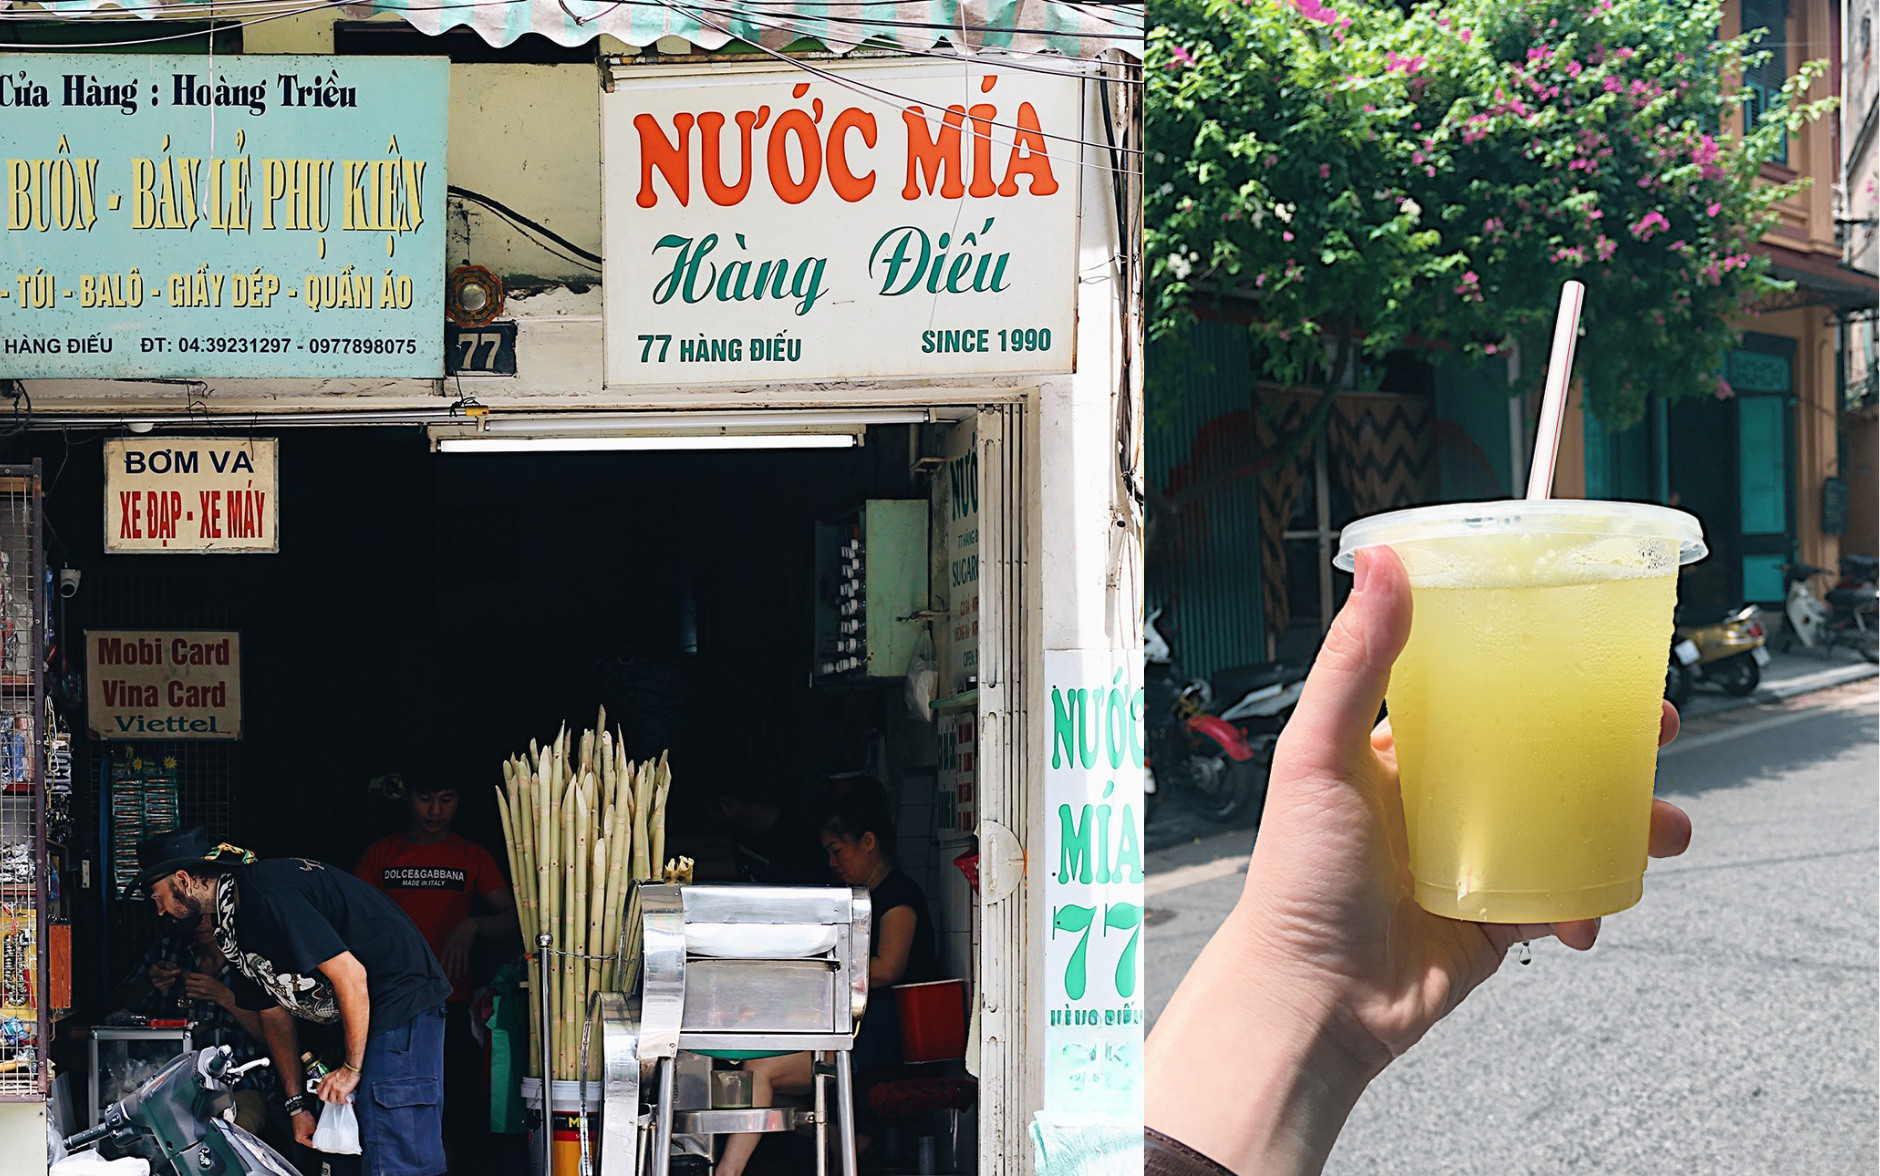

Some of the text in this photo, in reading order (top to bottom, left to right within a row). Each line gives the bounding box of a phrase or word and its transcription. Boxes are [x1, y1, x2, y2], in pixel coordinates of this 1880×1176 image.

[62, 74, 138, 116] Hàng
[172, 74, 266, 116] Hoàng
[278, 70, 357, 107] Triều
[633, 75, 1059, 208] NƯỚC MÍA
[5, 134, 99, 232] BUÔN
[131, 134, 200, 231] BÁN
[210, 128, 252, 235] LẺ
[262, 158, 333, 258] PHỤ
[342, 134, 426, 257] KIỆN
[652, 217, 1011, 316] Hàng Điếu
[17, 267, 55, 308] TÚI
[80, 267, 143, 308] BALÔ
[232, 267, 280, 308] DÉP
[380, 268, 412, 309] ÁO
[5, 334, 61, 354] HÀNG
[67, 332, 113, 354] ĐIẾU
[140, 337, 171, 354] ĐT:
[179, 338, 292, 354] 04.39231297
[309, 339, 416, 355] 0977898075
[458, 333, 501, 369] 77
[638, 329, 802, 363] 77 HÀNG ĐIẾU
[922, 328, 1052, 353] SINCE 1990
[125, 448, 254, 474] BƠM VA
[119, 491, 141, 539] XE
[147, 491, 182, 547] ĐẠP
[199, 491, 222, 539] XE
[227, 480, 265, 538] MÁY
[98, 638, 229, 666] Mobi Card
[102, 680, 226, 707] Vina Card
[114, 715, 217, 732] Viettel
[1058, 781, 1144, 884] MÍA
[384, 869, 464, 881] DOLCE&GABBANA
[1052, 902, 1144, 1000] 77
